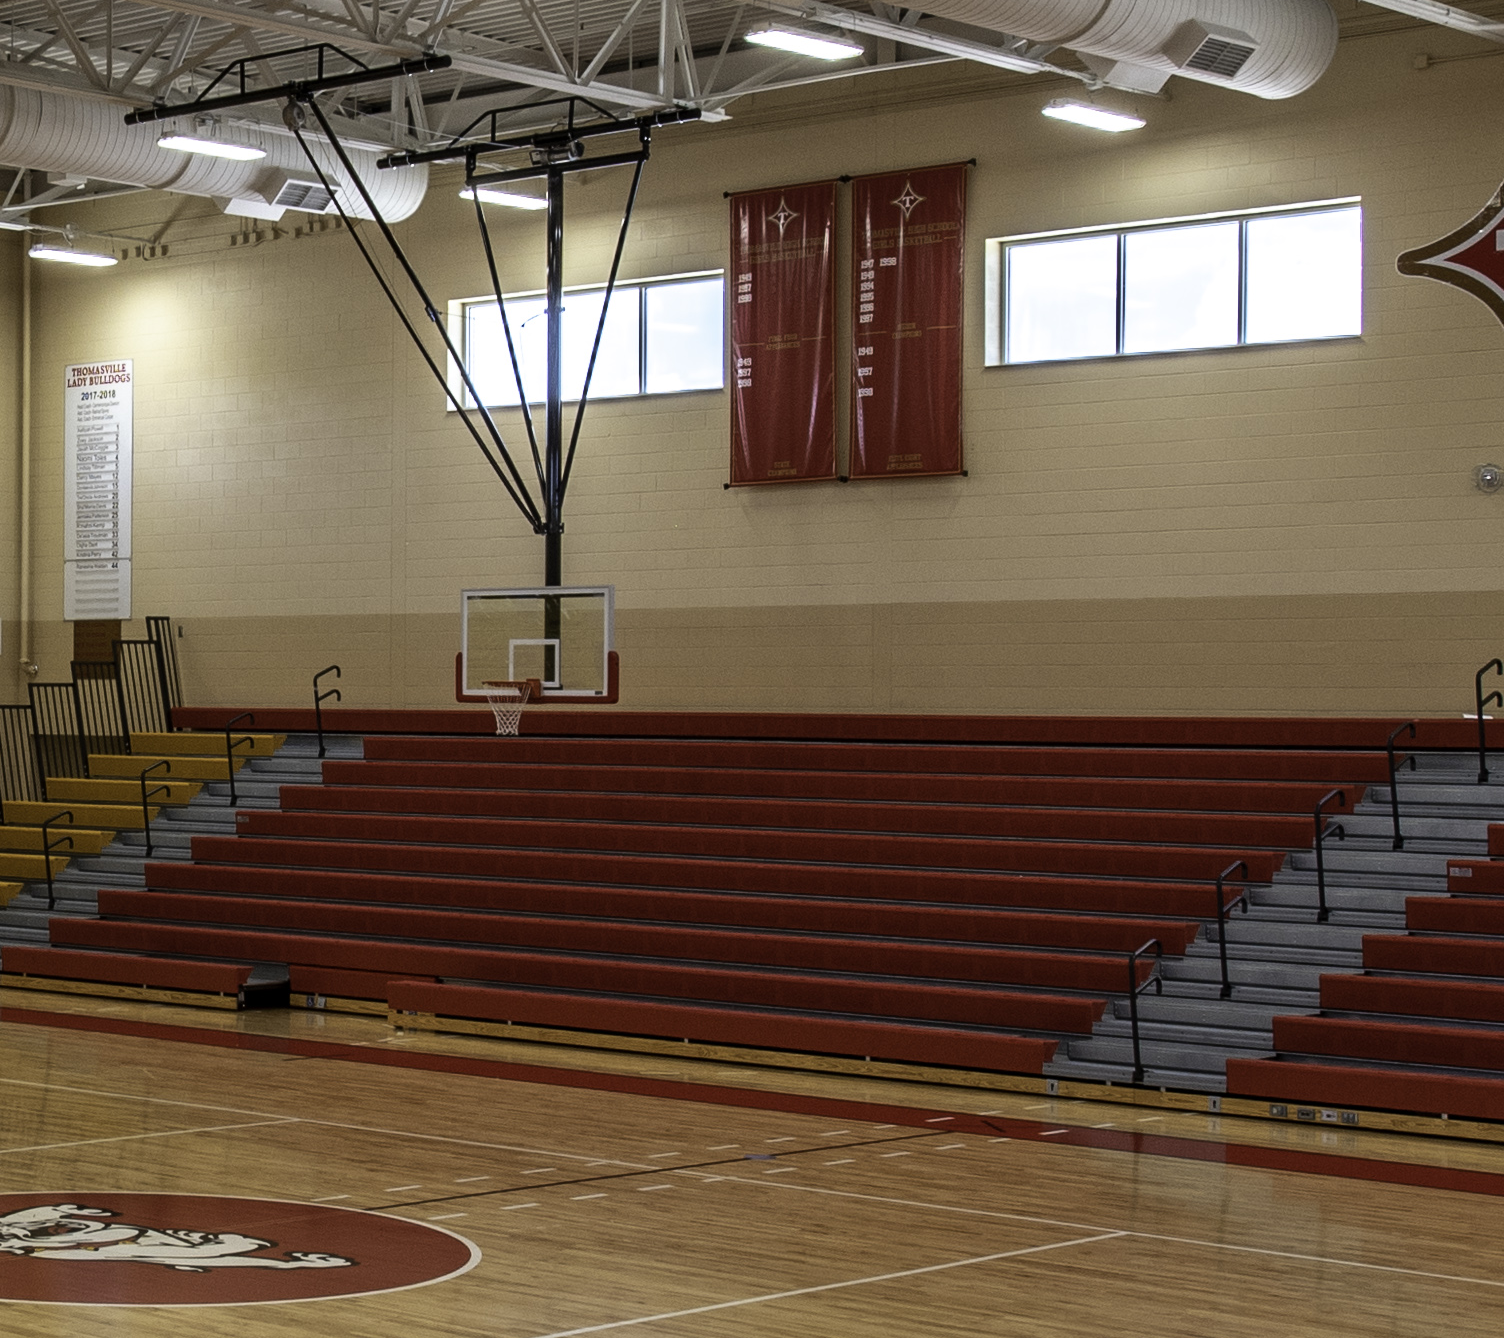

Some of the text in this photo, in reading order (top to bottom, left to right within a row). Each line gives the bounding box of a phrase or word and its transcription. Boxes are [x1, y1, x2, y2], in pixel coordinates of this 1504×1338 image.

[72, 364, 126, 377] THOMASVILLE
[67, 374, 130, 388] LADY BULLDOGS
[81, 390, 116, 400] 2017-2018
